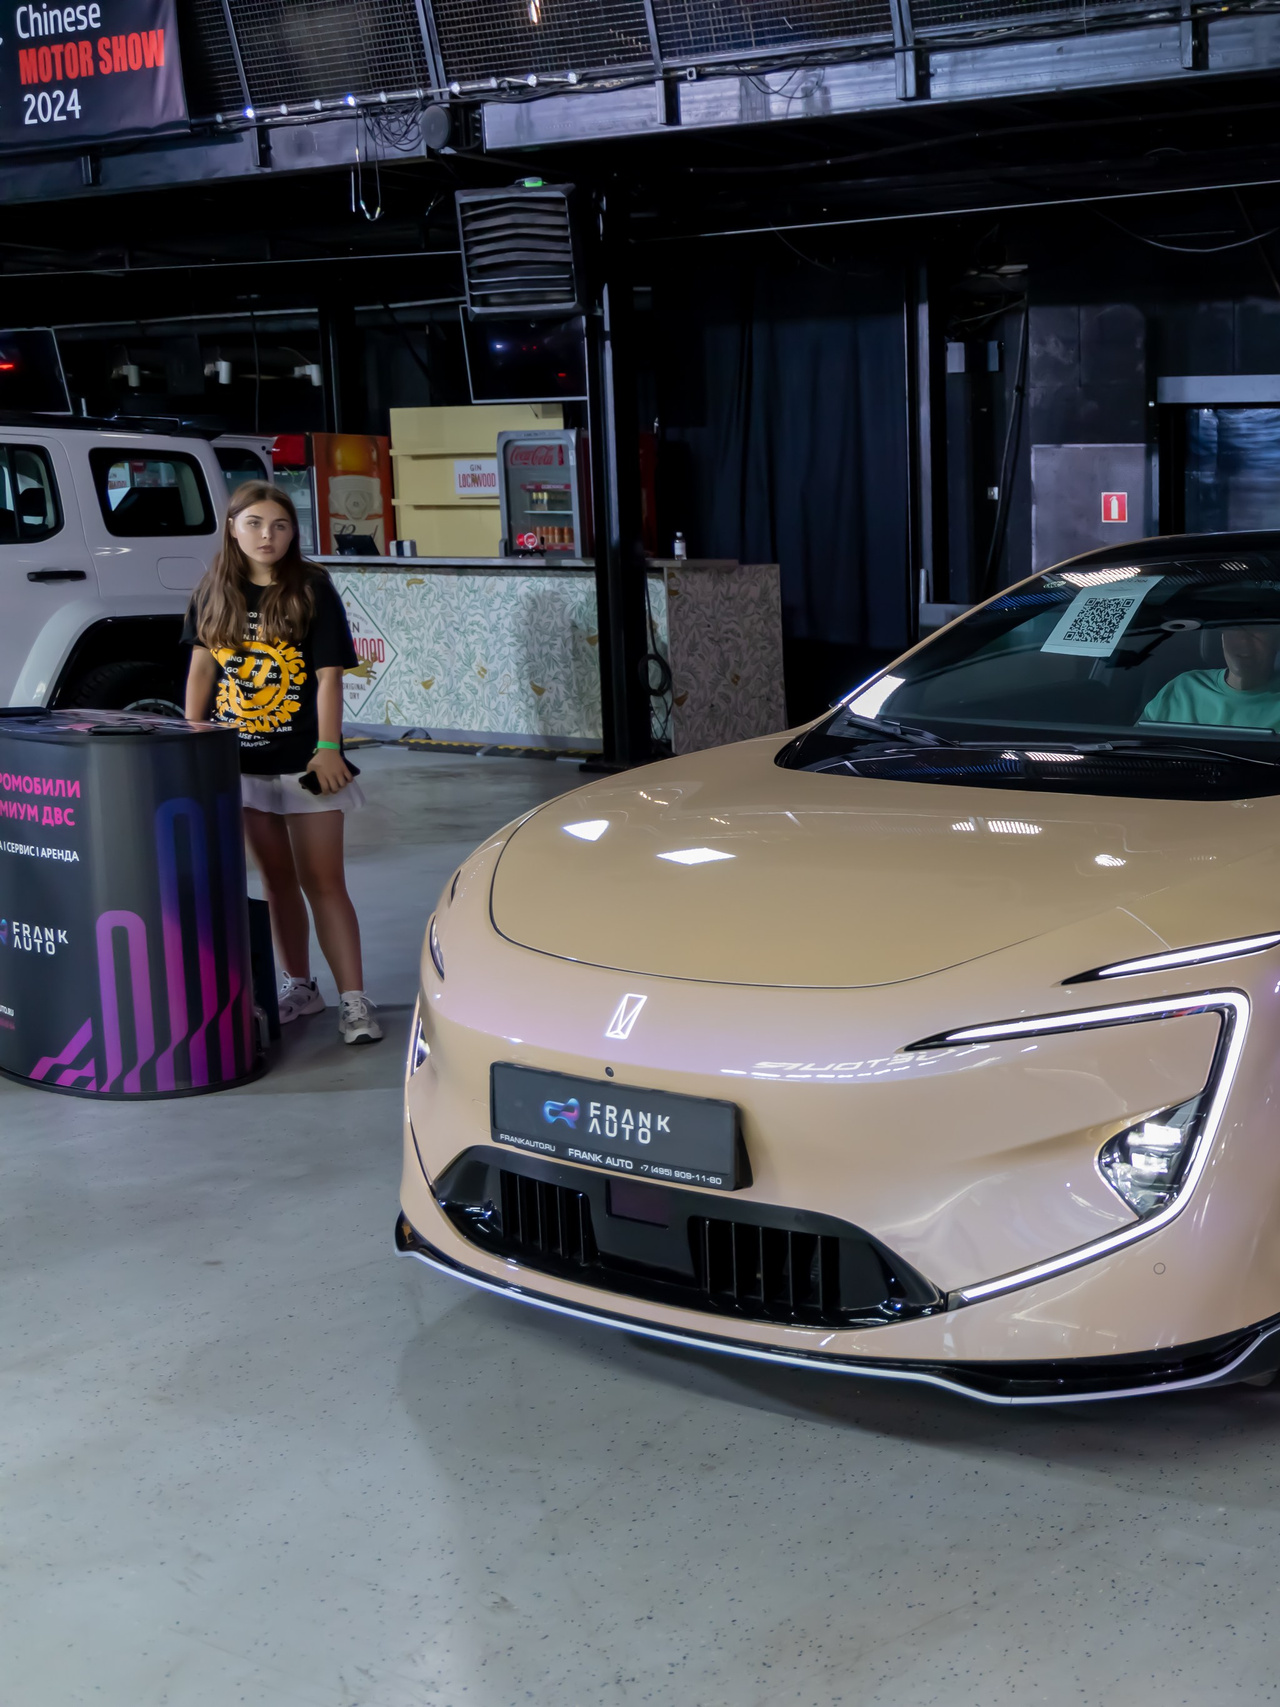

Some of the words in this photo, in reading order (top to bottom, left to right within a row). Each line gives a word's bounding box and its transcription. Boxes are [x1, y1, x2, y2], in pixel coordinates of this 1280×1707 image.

[16, 3, 101, 39] Chinese
[19, 40, 95, 85] MOTOR
[97, 29, 165, 75] SHOW
[24, 89, 82, 125] 2024
[470, 464, 482, 472] GIN
[0, 772, 81, 798] ОМОБИЛИ
[42, 806, 75, 827] ДВС
[7, 841, 35, 857] СЕРВИС
[41, 847, 80, 862] АРЕНДА
[13, 921, 69, 944] FRANK
[14, 935, 56, 955] AUTO
[590, 1102, 671, 1133] FRANK
[588, 1117, 651, 1144] AUTO
[500, 1133, 556, 1152] FRANKAUTO.RU
[568, 1148, 602, 1163] FRANK
[605, 1155, 633, 1169] AUTO
